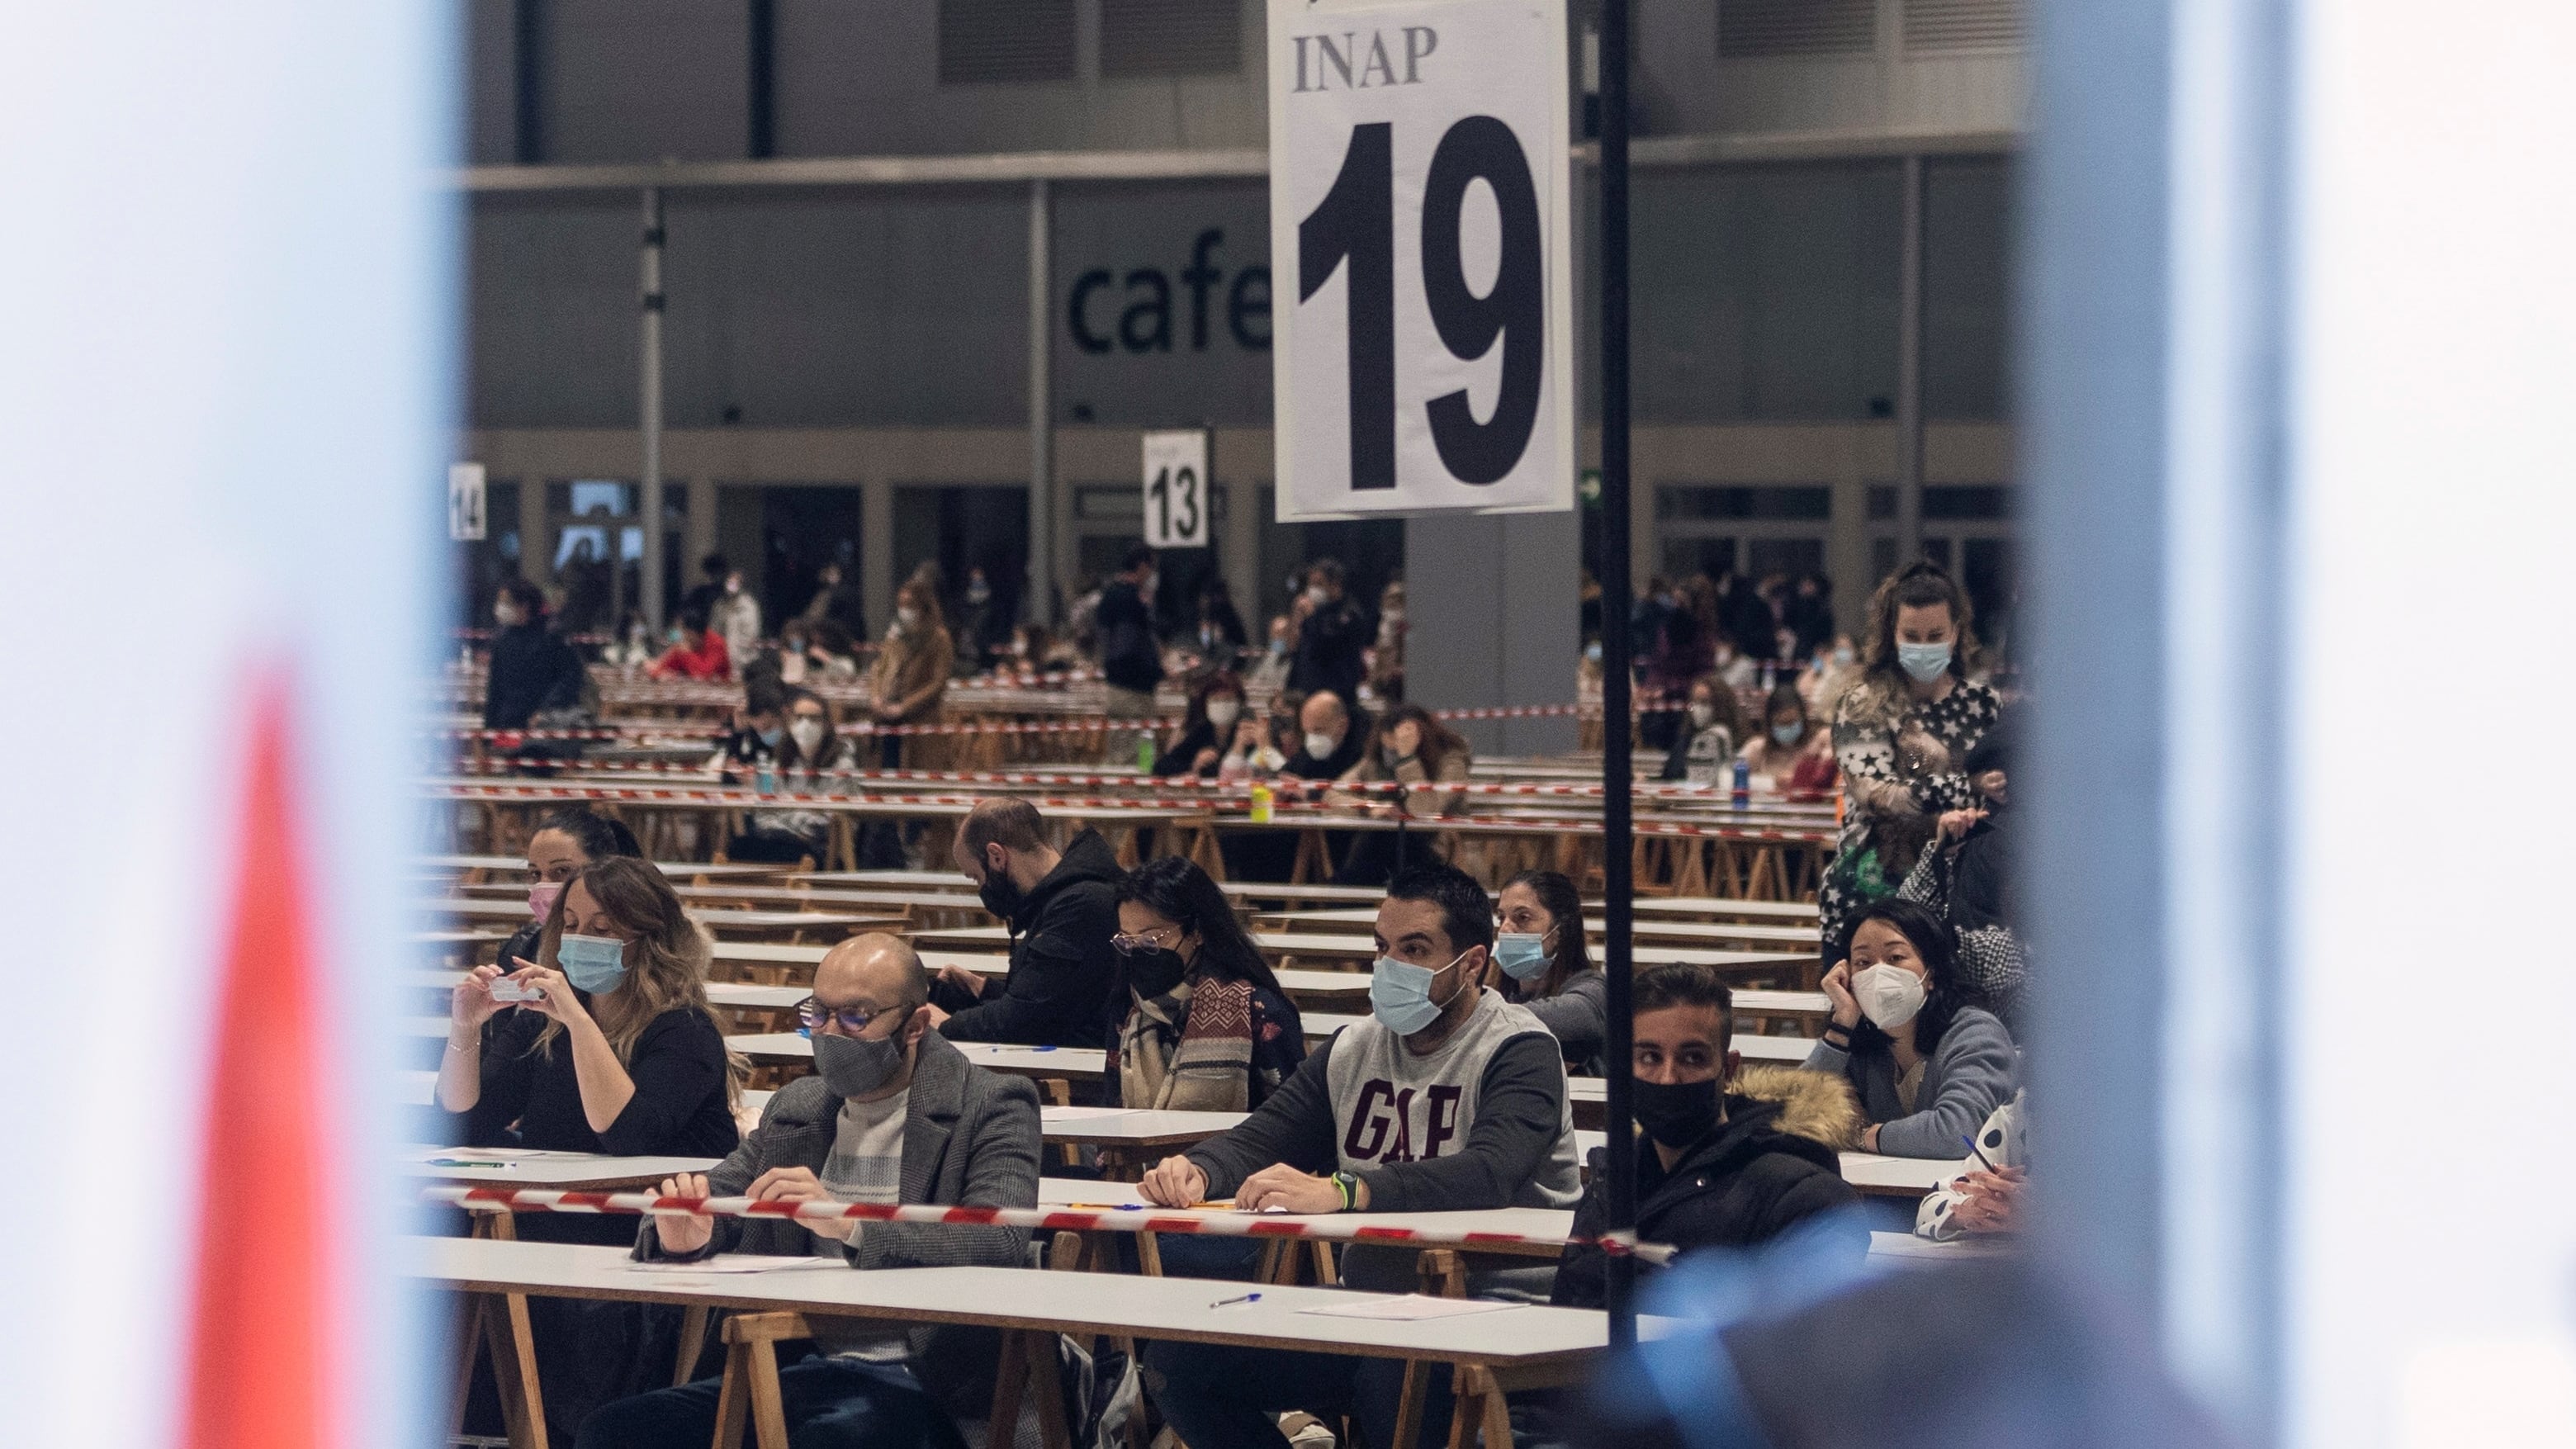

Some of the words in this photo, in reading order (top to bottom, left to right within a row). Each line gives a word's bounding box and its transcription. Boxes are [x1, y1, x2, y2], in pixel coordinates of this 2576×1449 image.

[1292, 26, 1438, 92] INAP
[1299, 115, 1544, 491] 19
[1151, 466, 1198, 540] 13
[1344, 1078, 1462, 1164] GAP
